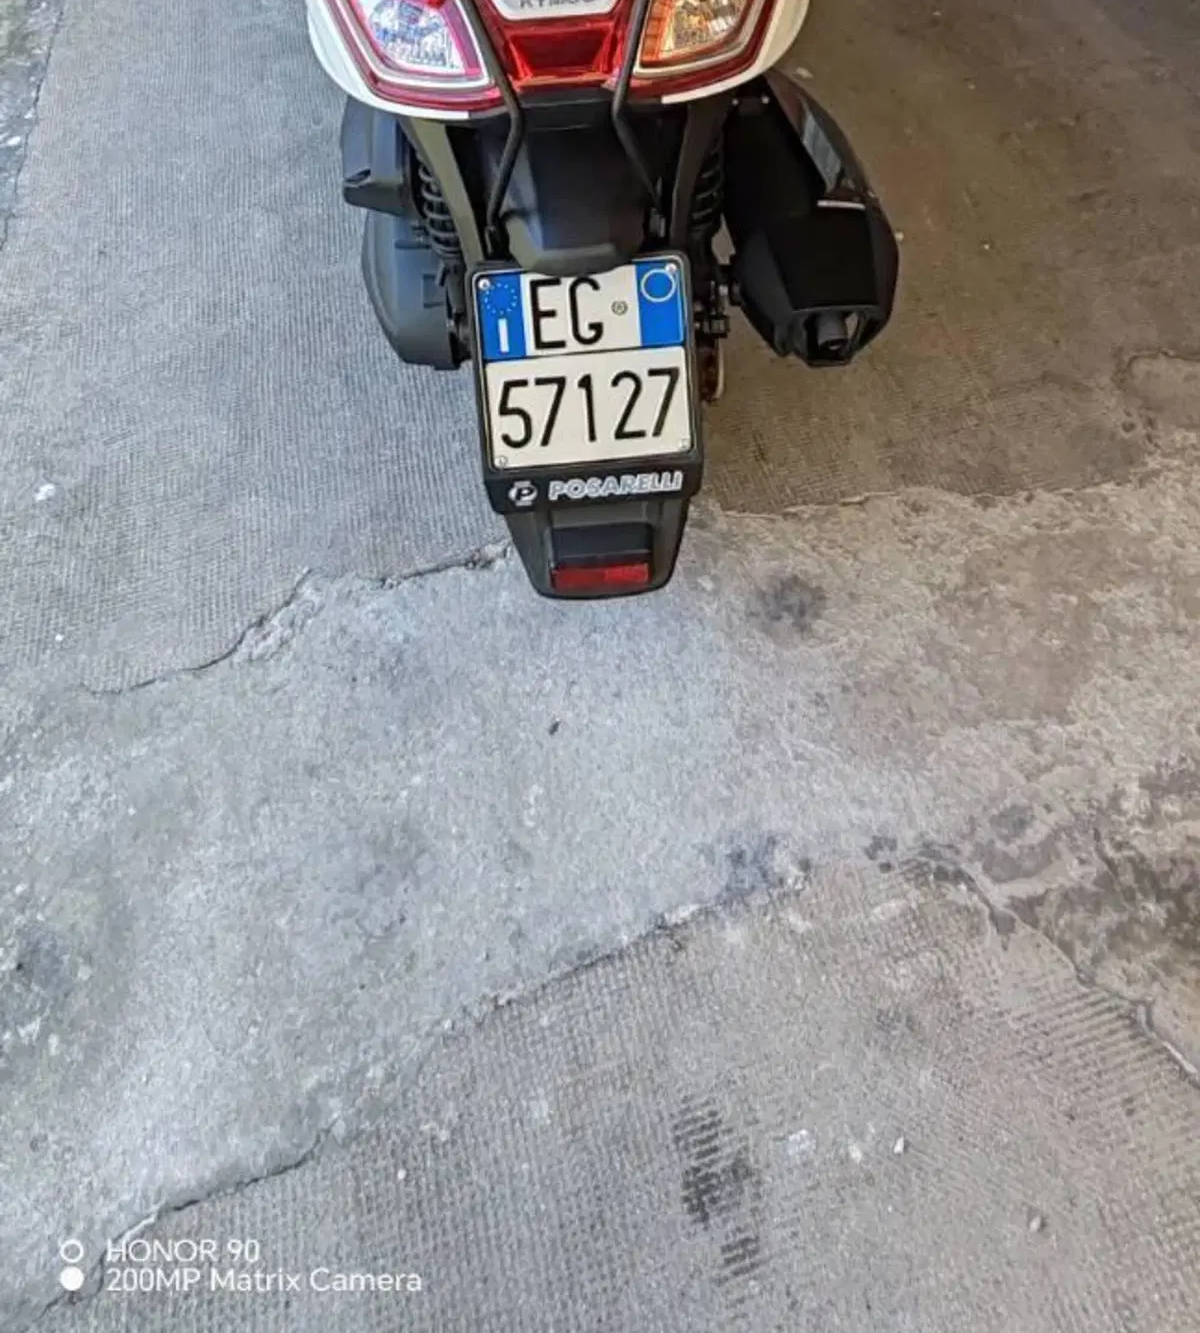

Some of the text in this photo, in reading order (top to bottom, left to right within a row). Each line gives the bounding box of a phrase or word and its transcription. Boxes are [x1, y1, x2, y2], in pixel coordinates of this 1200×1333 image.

[530, 278, 604, 349] EG
[498, 367, 680, 449] 57127
[549, 471, 683, 501] POSARELLI
